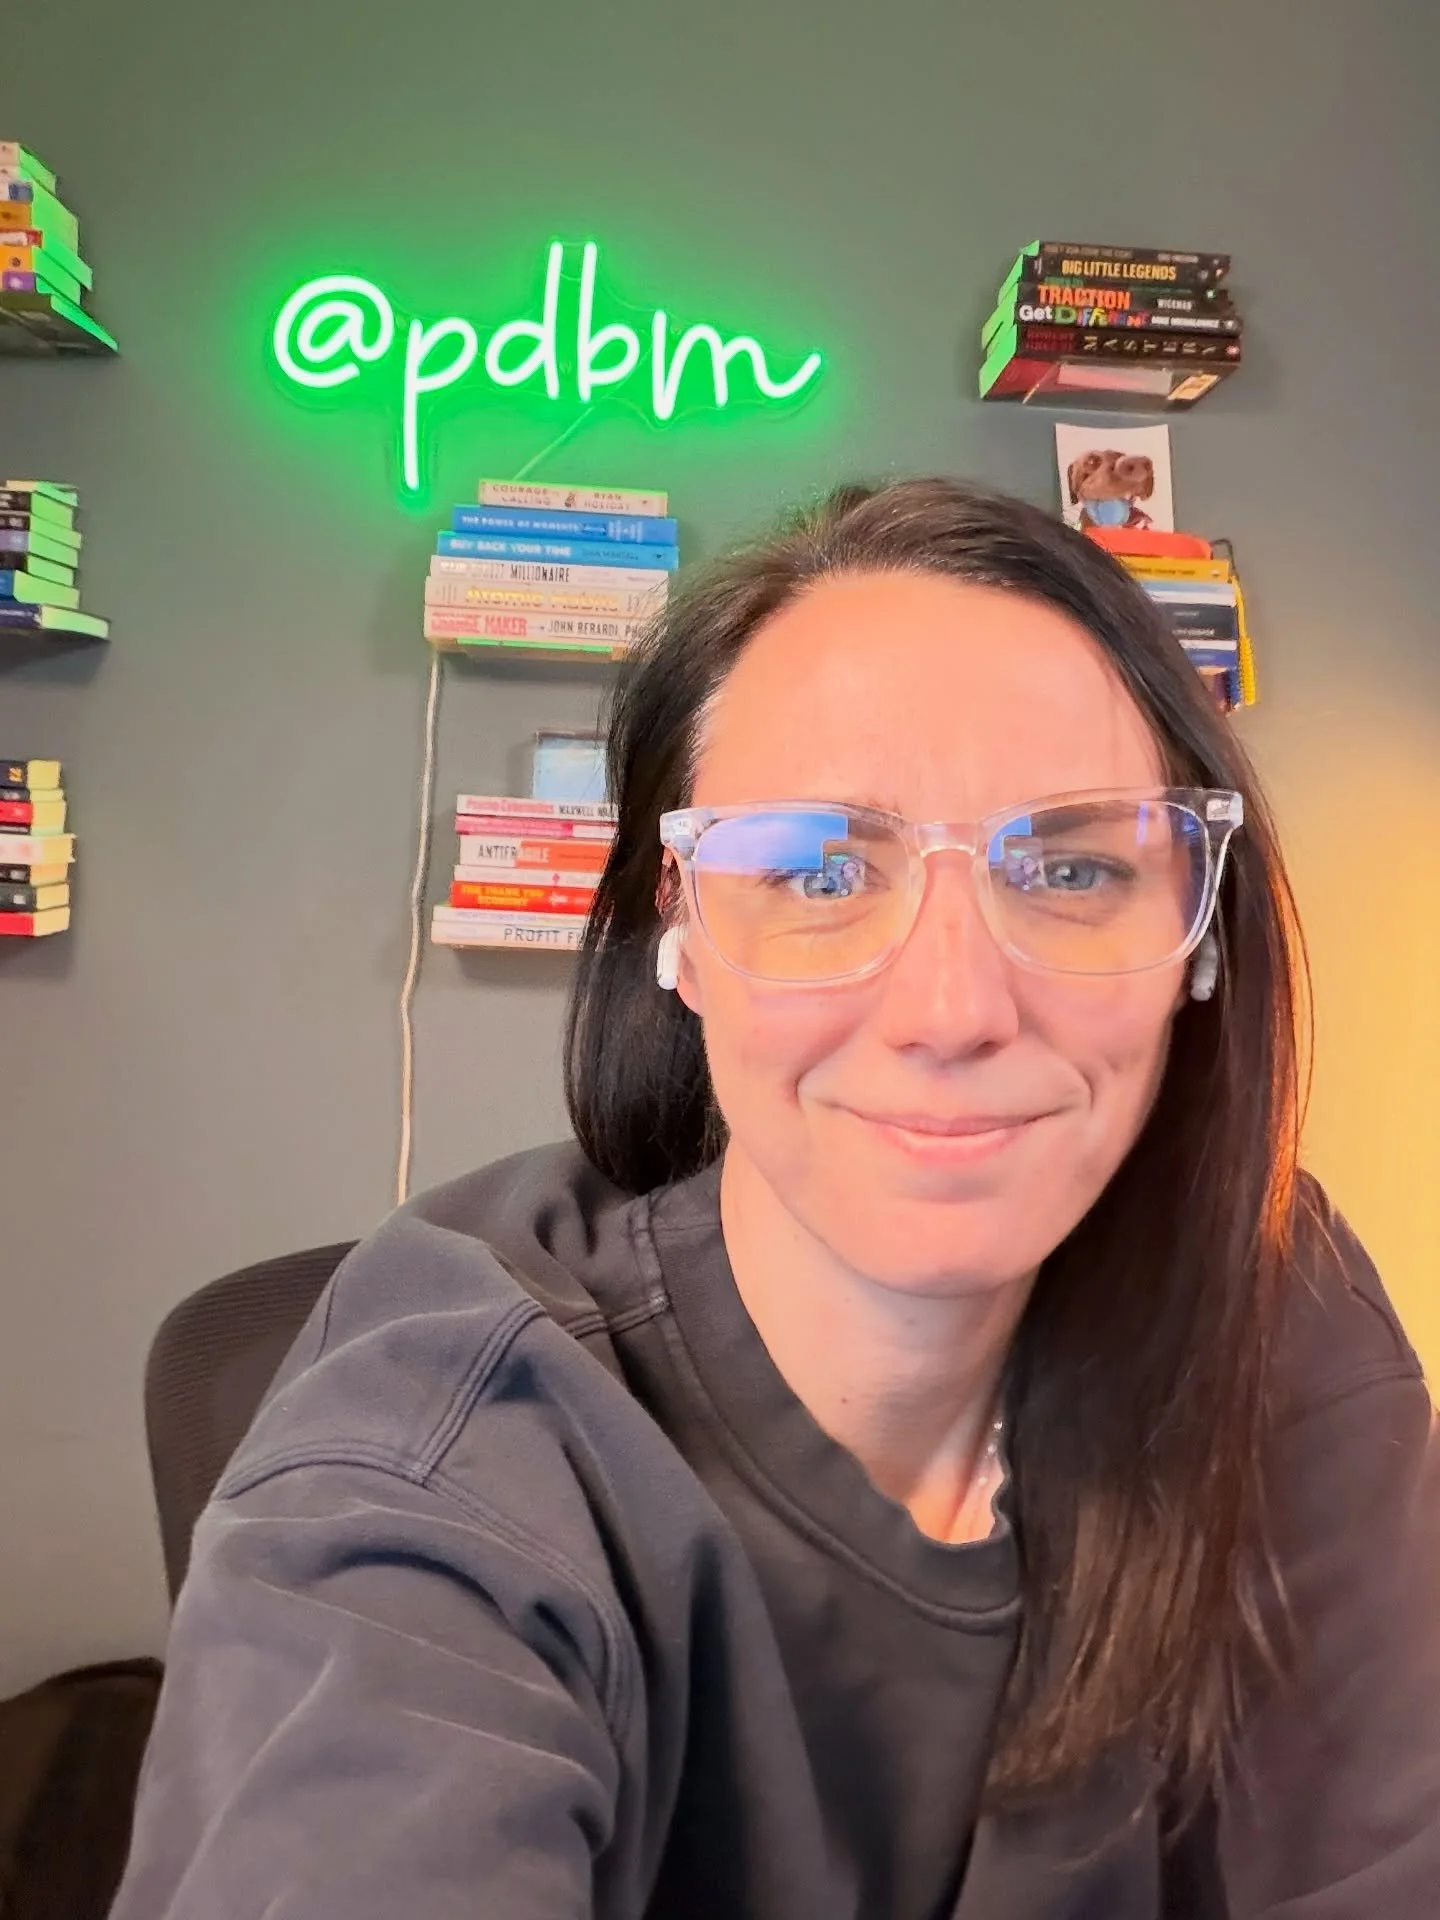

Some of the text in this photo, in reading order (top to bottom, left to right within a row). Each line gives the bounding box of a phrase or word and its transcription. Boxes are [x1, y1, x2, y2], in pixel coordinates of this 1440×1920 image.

[1062, 260, 1082, 275] BIG
[1084, 261, 1121, 278] LITTLE
[1123, 263, 1177, 281] LEGENDS
[1038, 284, 1131, 310] TRACTION
[1018, 305, 1053, 322] Get
[273, 240, 822, 490] @pdbm
[492, 484, 548, 496] COURAGE
[594, 492, 622, 501] RYAN
[462, 515, 479, 525] THE
[481, 517, 514, 528] POWER
[516, 519, 530, 529] OF
[532, 520, 580, 532] MOMENTS
[450, 539, 572, 557] BUY BACK YOUR TIME
[510, 564, 570, 583] MILLIONAIRE
[484, 613, 528, 637] MAKER
[548, 619, 573, 633] JOHN
[504, 926, 561, 943] PROFIT
